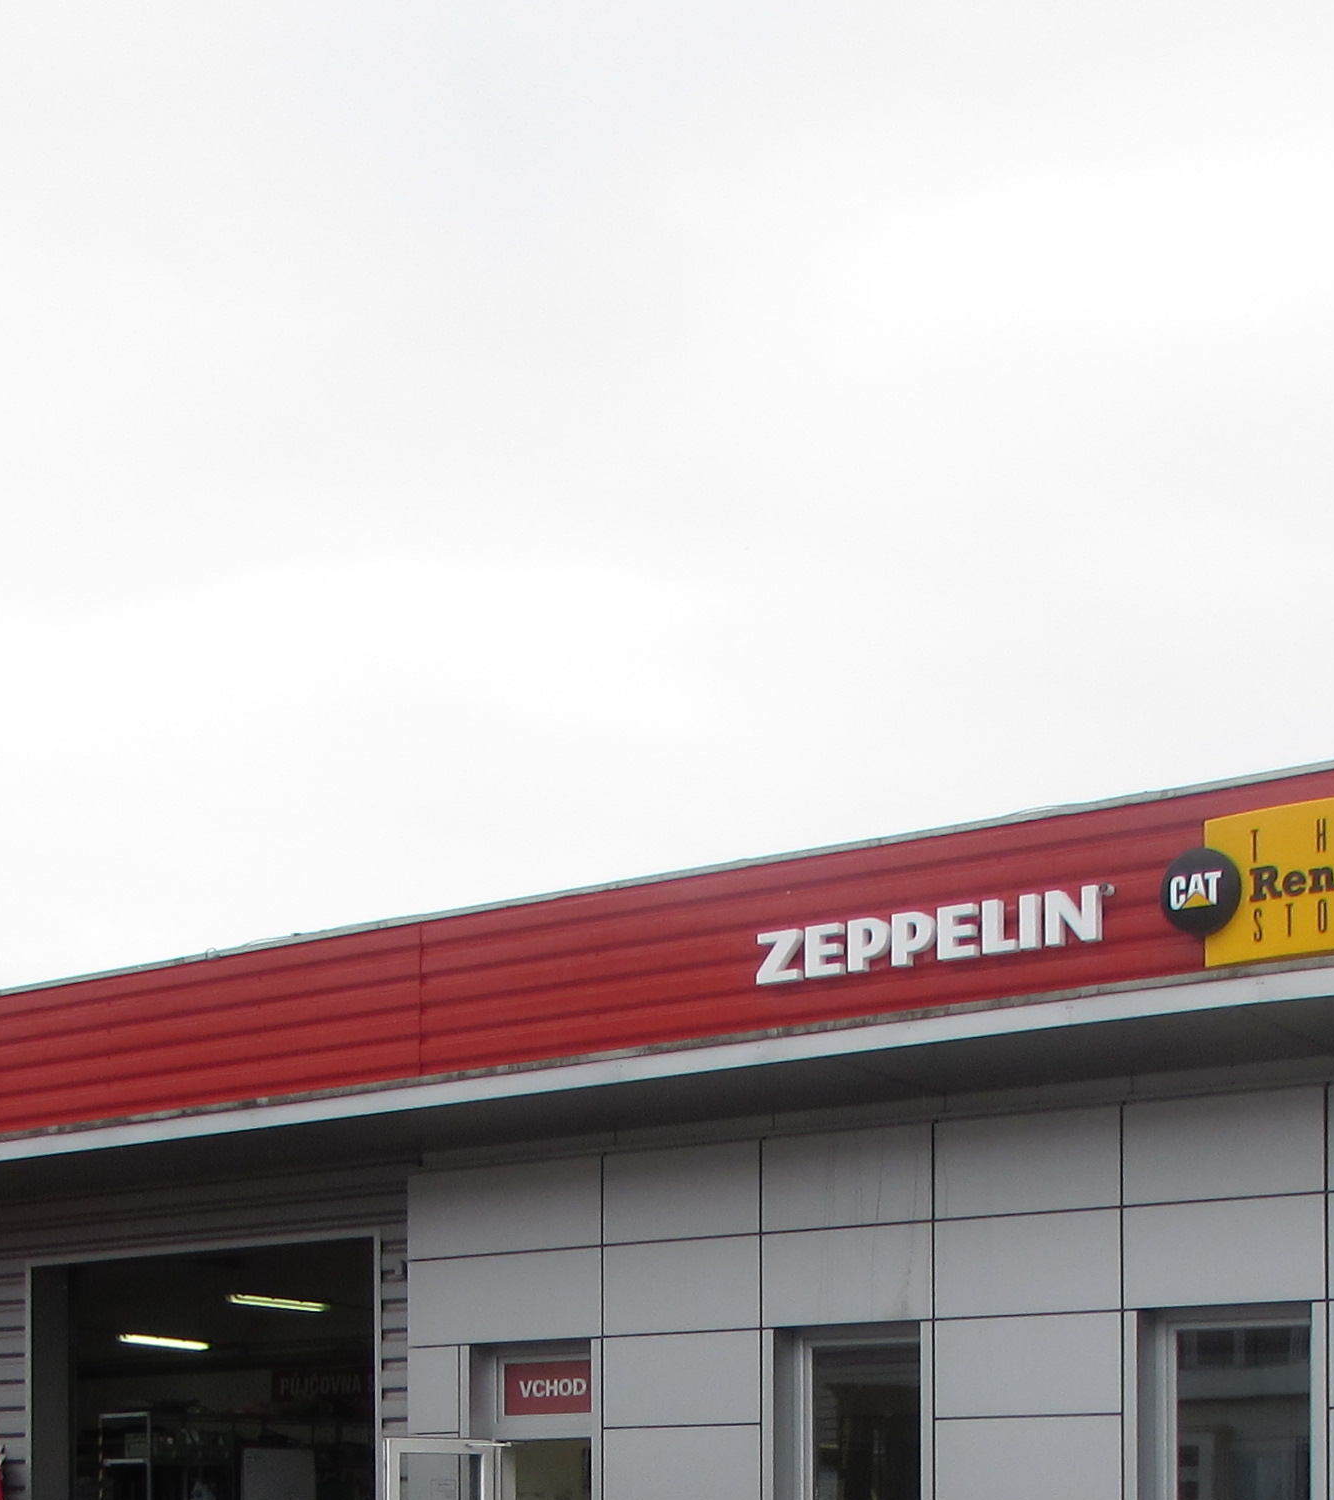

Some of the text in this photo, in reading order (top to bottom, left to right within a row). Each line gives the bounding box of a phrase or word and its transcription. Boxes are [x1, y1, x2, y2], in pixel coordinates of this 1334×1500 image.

[1170, 870, 1224, 911] CAT
[755, 884, 1104, 986] ZEPPELIN
[518, 1378, 588, 1398] VCHOD
